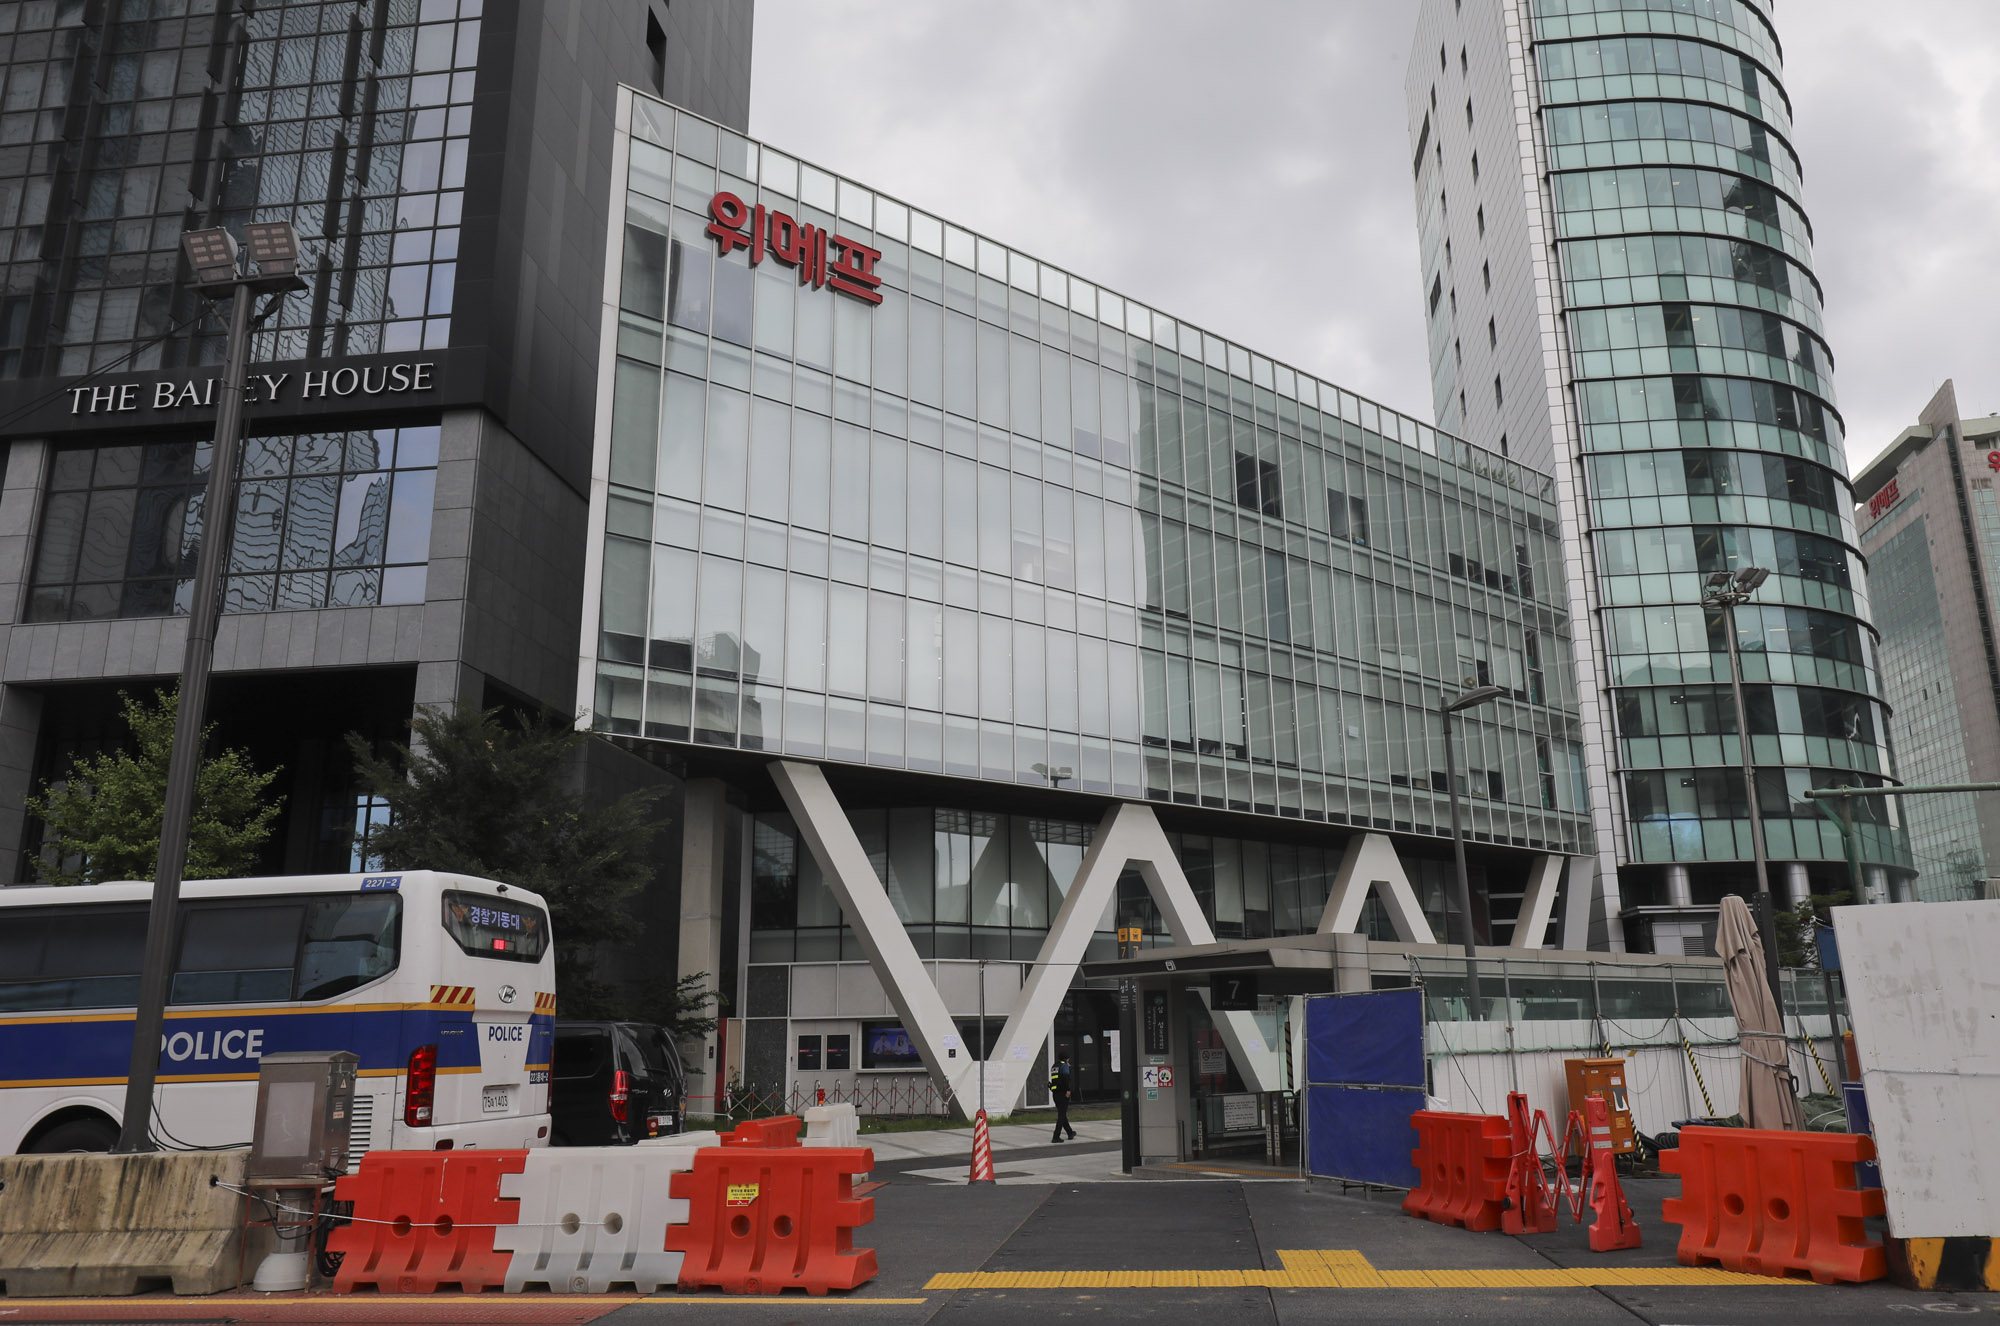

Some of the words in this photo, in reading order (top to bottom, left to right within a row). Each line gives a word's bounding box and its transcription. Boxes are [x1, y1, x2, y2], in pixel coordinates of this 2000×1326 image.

[708, 191, 884, 305] 위메프
[67, 383, 140, 415] THE
[153, 372, 289, 410] BAIEY
[302, 362, 435, 399] HOUSE
[1869, 479, 1899, 519] 위메프
[1120, 946, 1127, 958] 7
[1228, 980, 1240, 1000] 7
[489, 1026, 522, 1041] POLICE
